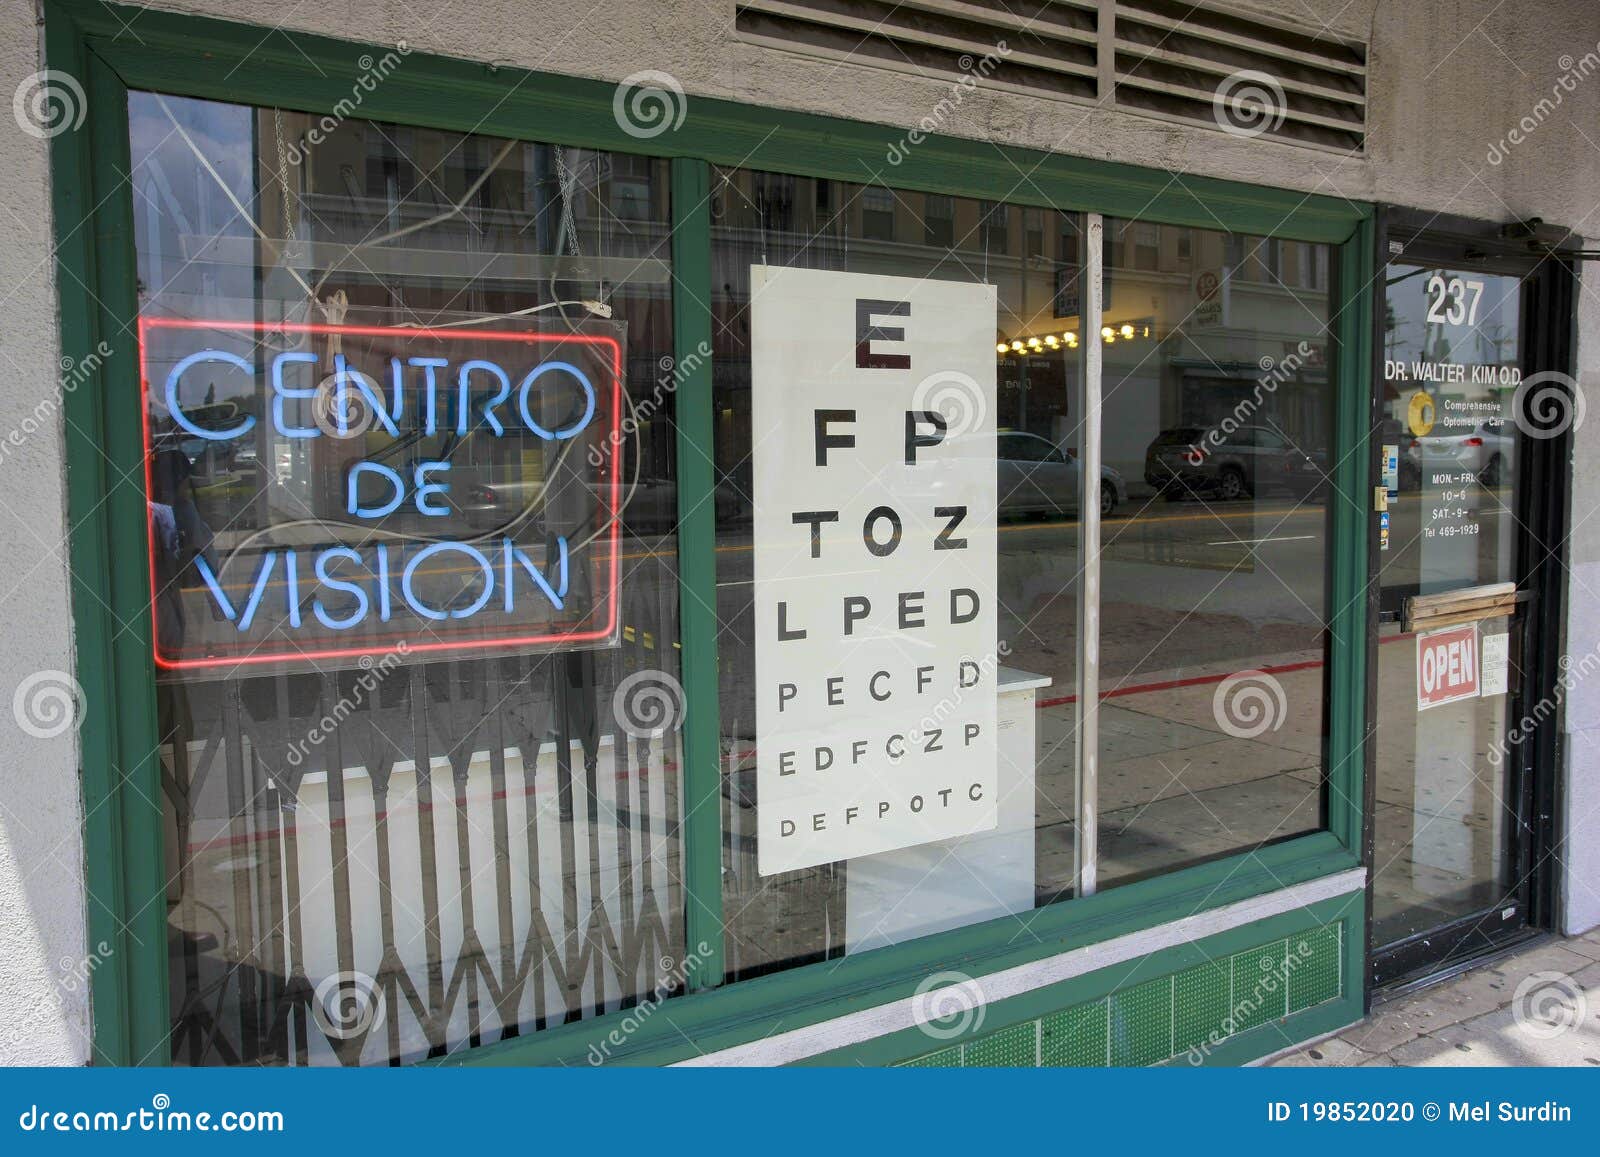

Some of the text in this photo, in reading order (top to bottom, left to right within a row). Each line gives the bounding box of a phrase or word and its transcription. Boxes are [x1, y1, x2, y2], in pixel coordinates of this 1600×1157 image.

[1427, 276, 1484, 326] 237
[855, 298, 912, 370] E
[165, 350, 596, 441] CENTRO
[1385, 360, 1408, 381] DR.
[1412, 362, 1465, 383] WALTER
[1471, 365, 1496, 384] KIM
[1444, 400, 1501, 413] Comprehensive
[1489, 416, 1505, 426] Care
[347, 461, 450, 518] DE
[1424, 524, 1479, 538] Tel 469-1929
[199, 536, 569, 630] VISION
[1422, 639, 1474, 694] OPEN
